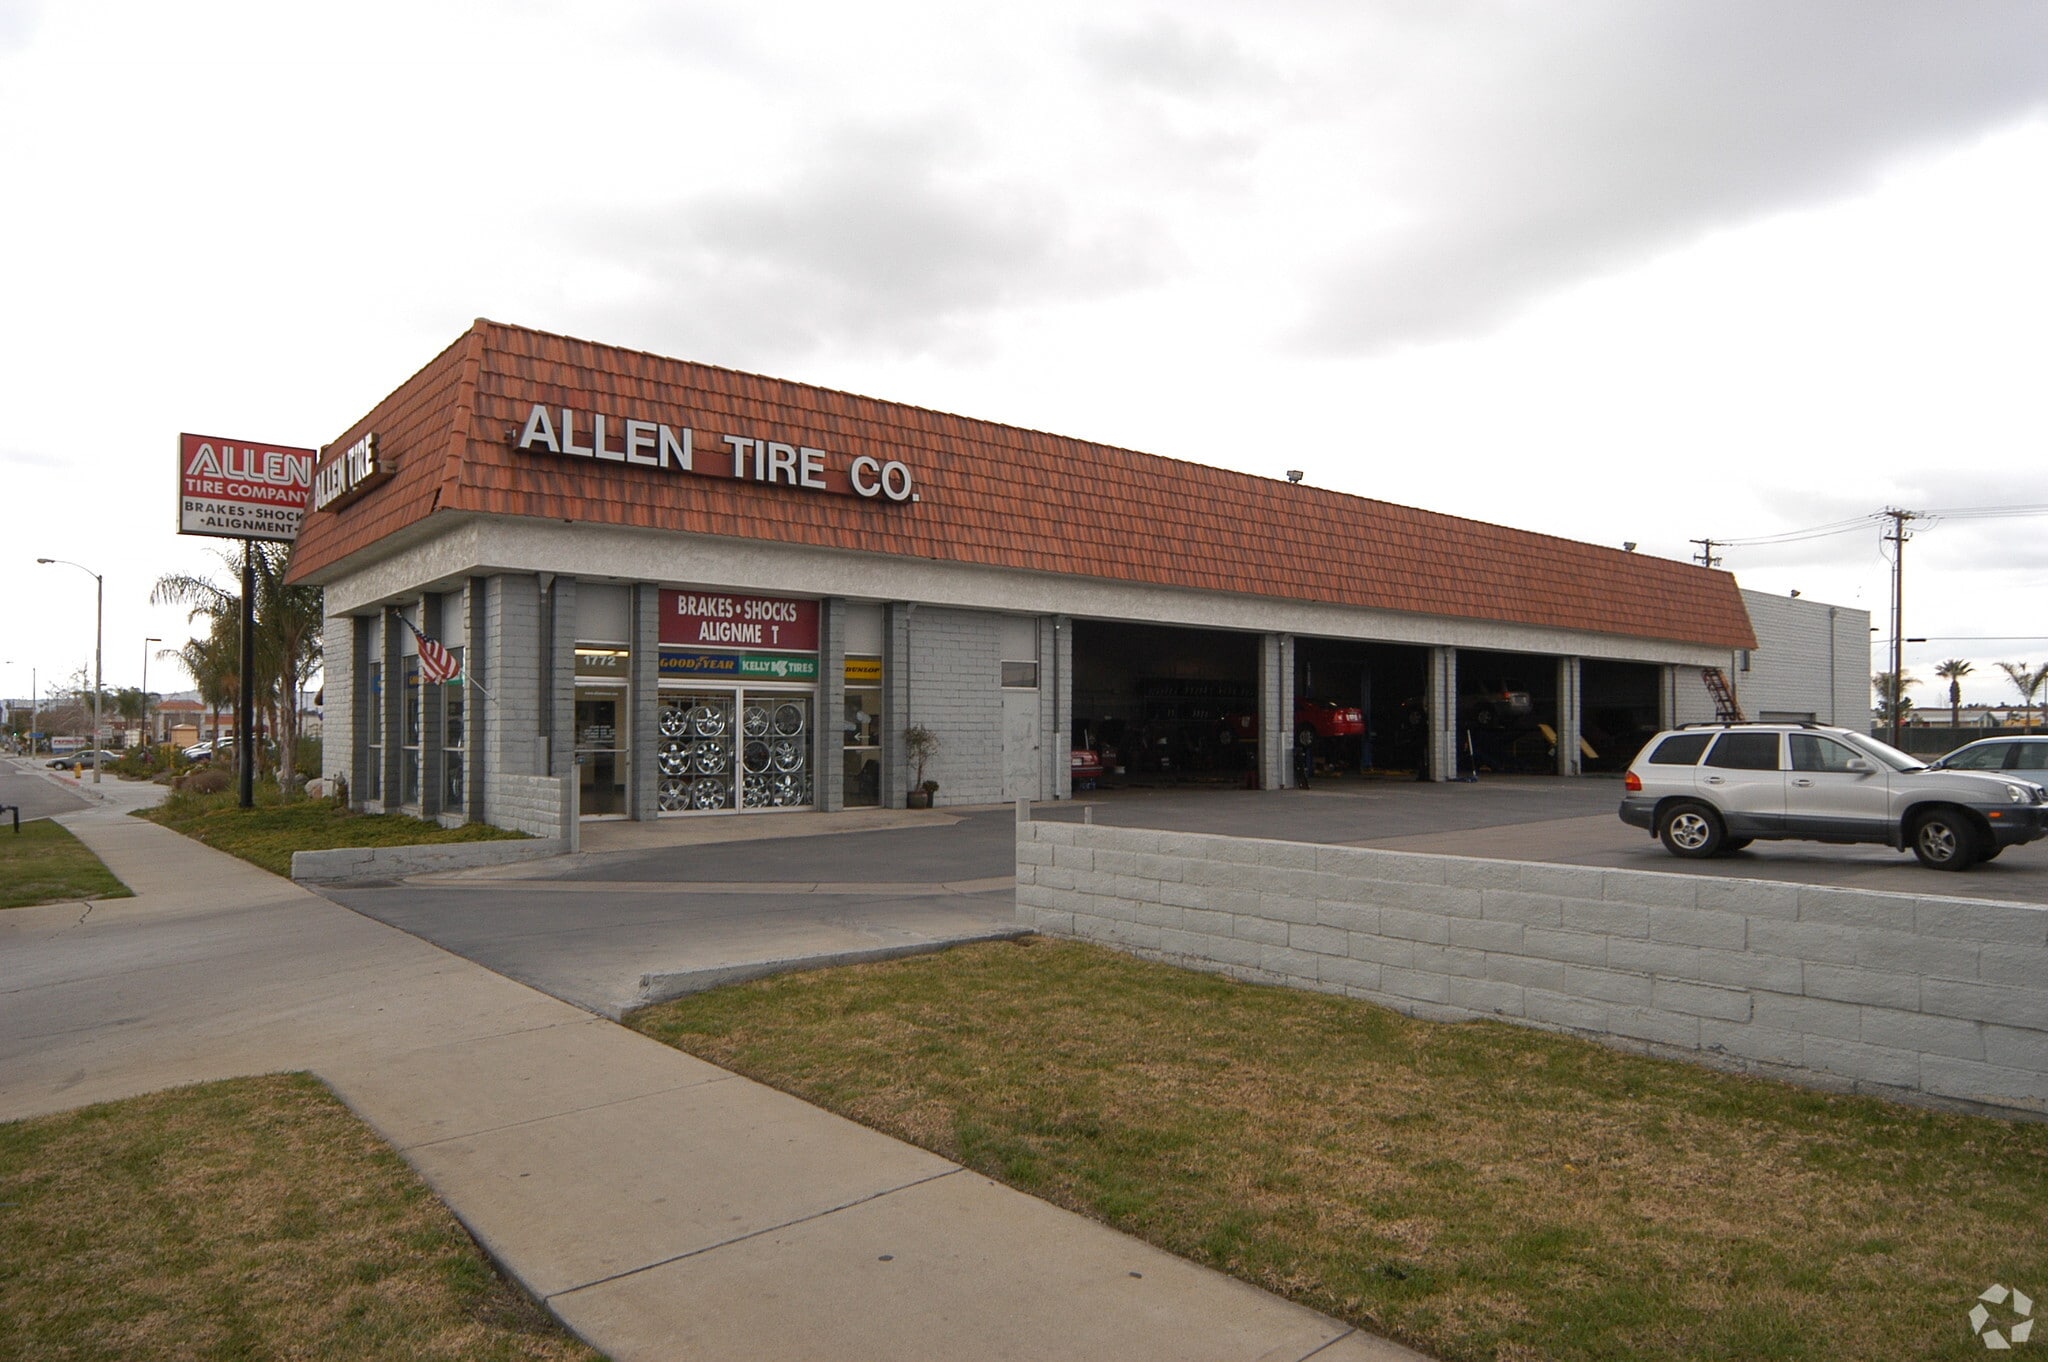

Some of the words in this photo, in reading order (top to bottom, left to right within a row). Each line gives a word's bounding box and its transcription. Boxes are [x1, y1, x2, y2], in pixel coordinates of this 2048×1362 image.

[518, 404, 693, 472] ALLEN
[724, 434, 827, 490] TIRE
[849, 455, 920, 502] CO.
[186, 443, 312, 488] ALLEN
[314, 454, 347, 512] ALLEN
[347, 432, 374, 487] TIRE
[185, 478, 223, 495] TIRE
[227, 483, 310, 503] COMPANY
[185, 501, 245, 516] BRAKES
[206, 517, 294, 533] ALIGNMENT
[678, 595, 733, 619] BRAKES
[744, 600, 797, 623] SHOCKS
[583, 655, 617, 667] 1772
[742, 660, 771, 672] KELLY
[788, 663, 814, 674] TIRES
[845, 666, 881, 674] DUNLOP
